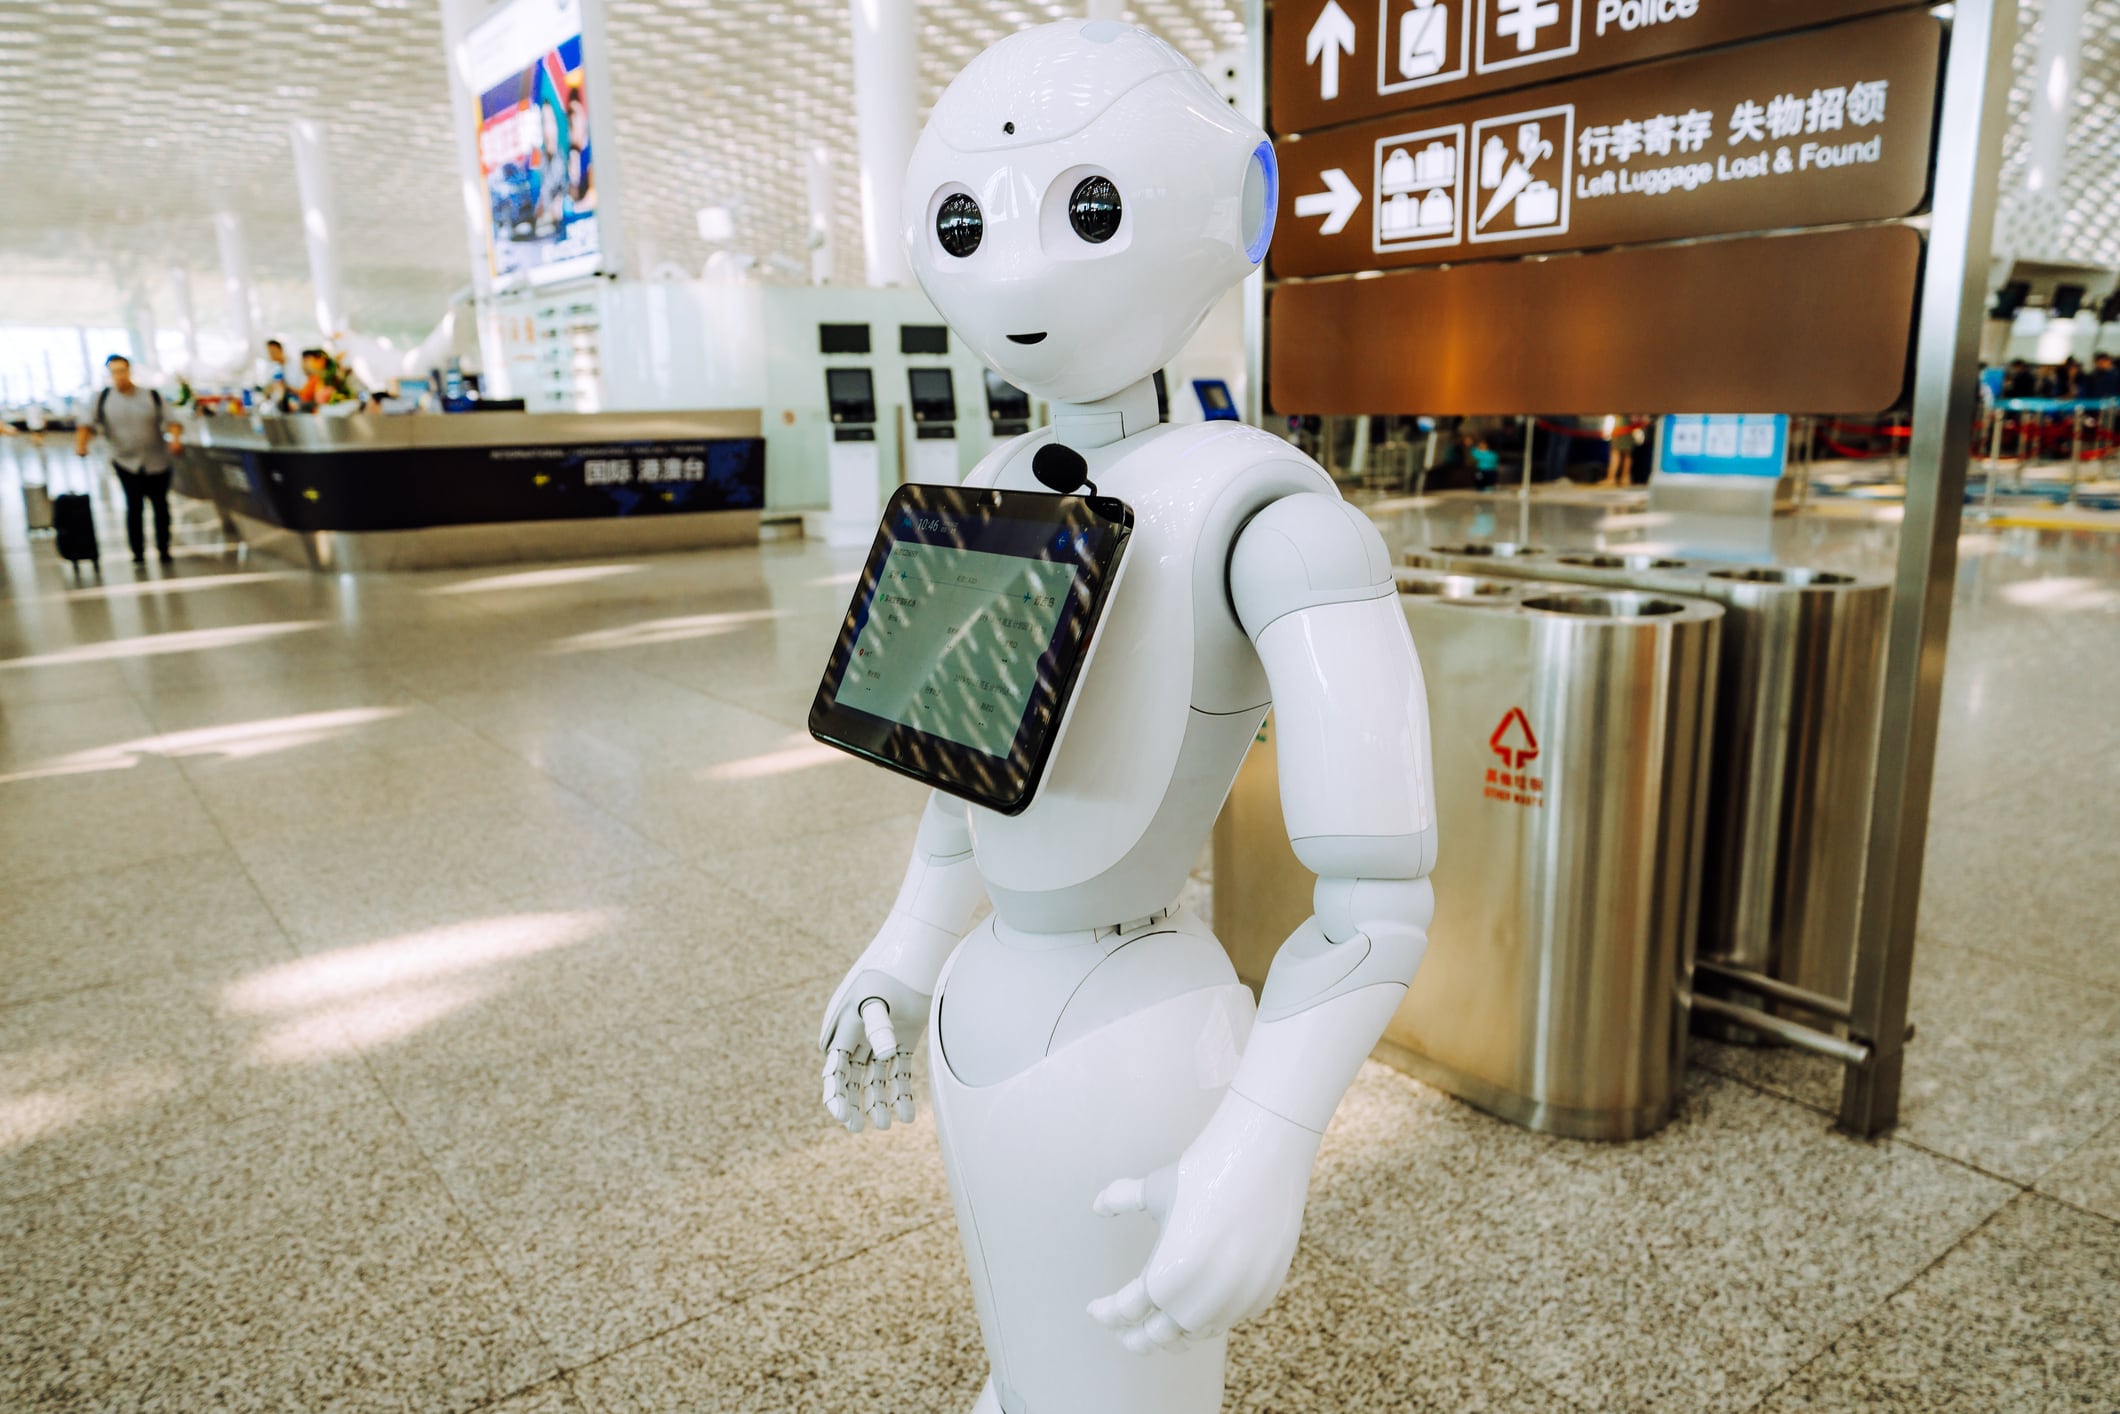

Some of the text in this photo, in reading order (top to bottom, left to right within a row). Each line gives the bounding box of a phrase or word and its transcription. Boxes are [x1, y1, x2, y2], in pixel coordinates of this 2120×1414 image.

[1596, 0, 1699, 36] Police
[1578, 80, 1888, 167] 行李寄存 失物招领
[1576, 134, 1882, 199] Left Luggage Lost & Found
[584, 459, 632, 486] 国际
[917, 518, 940, 532] 10:46
